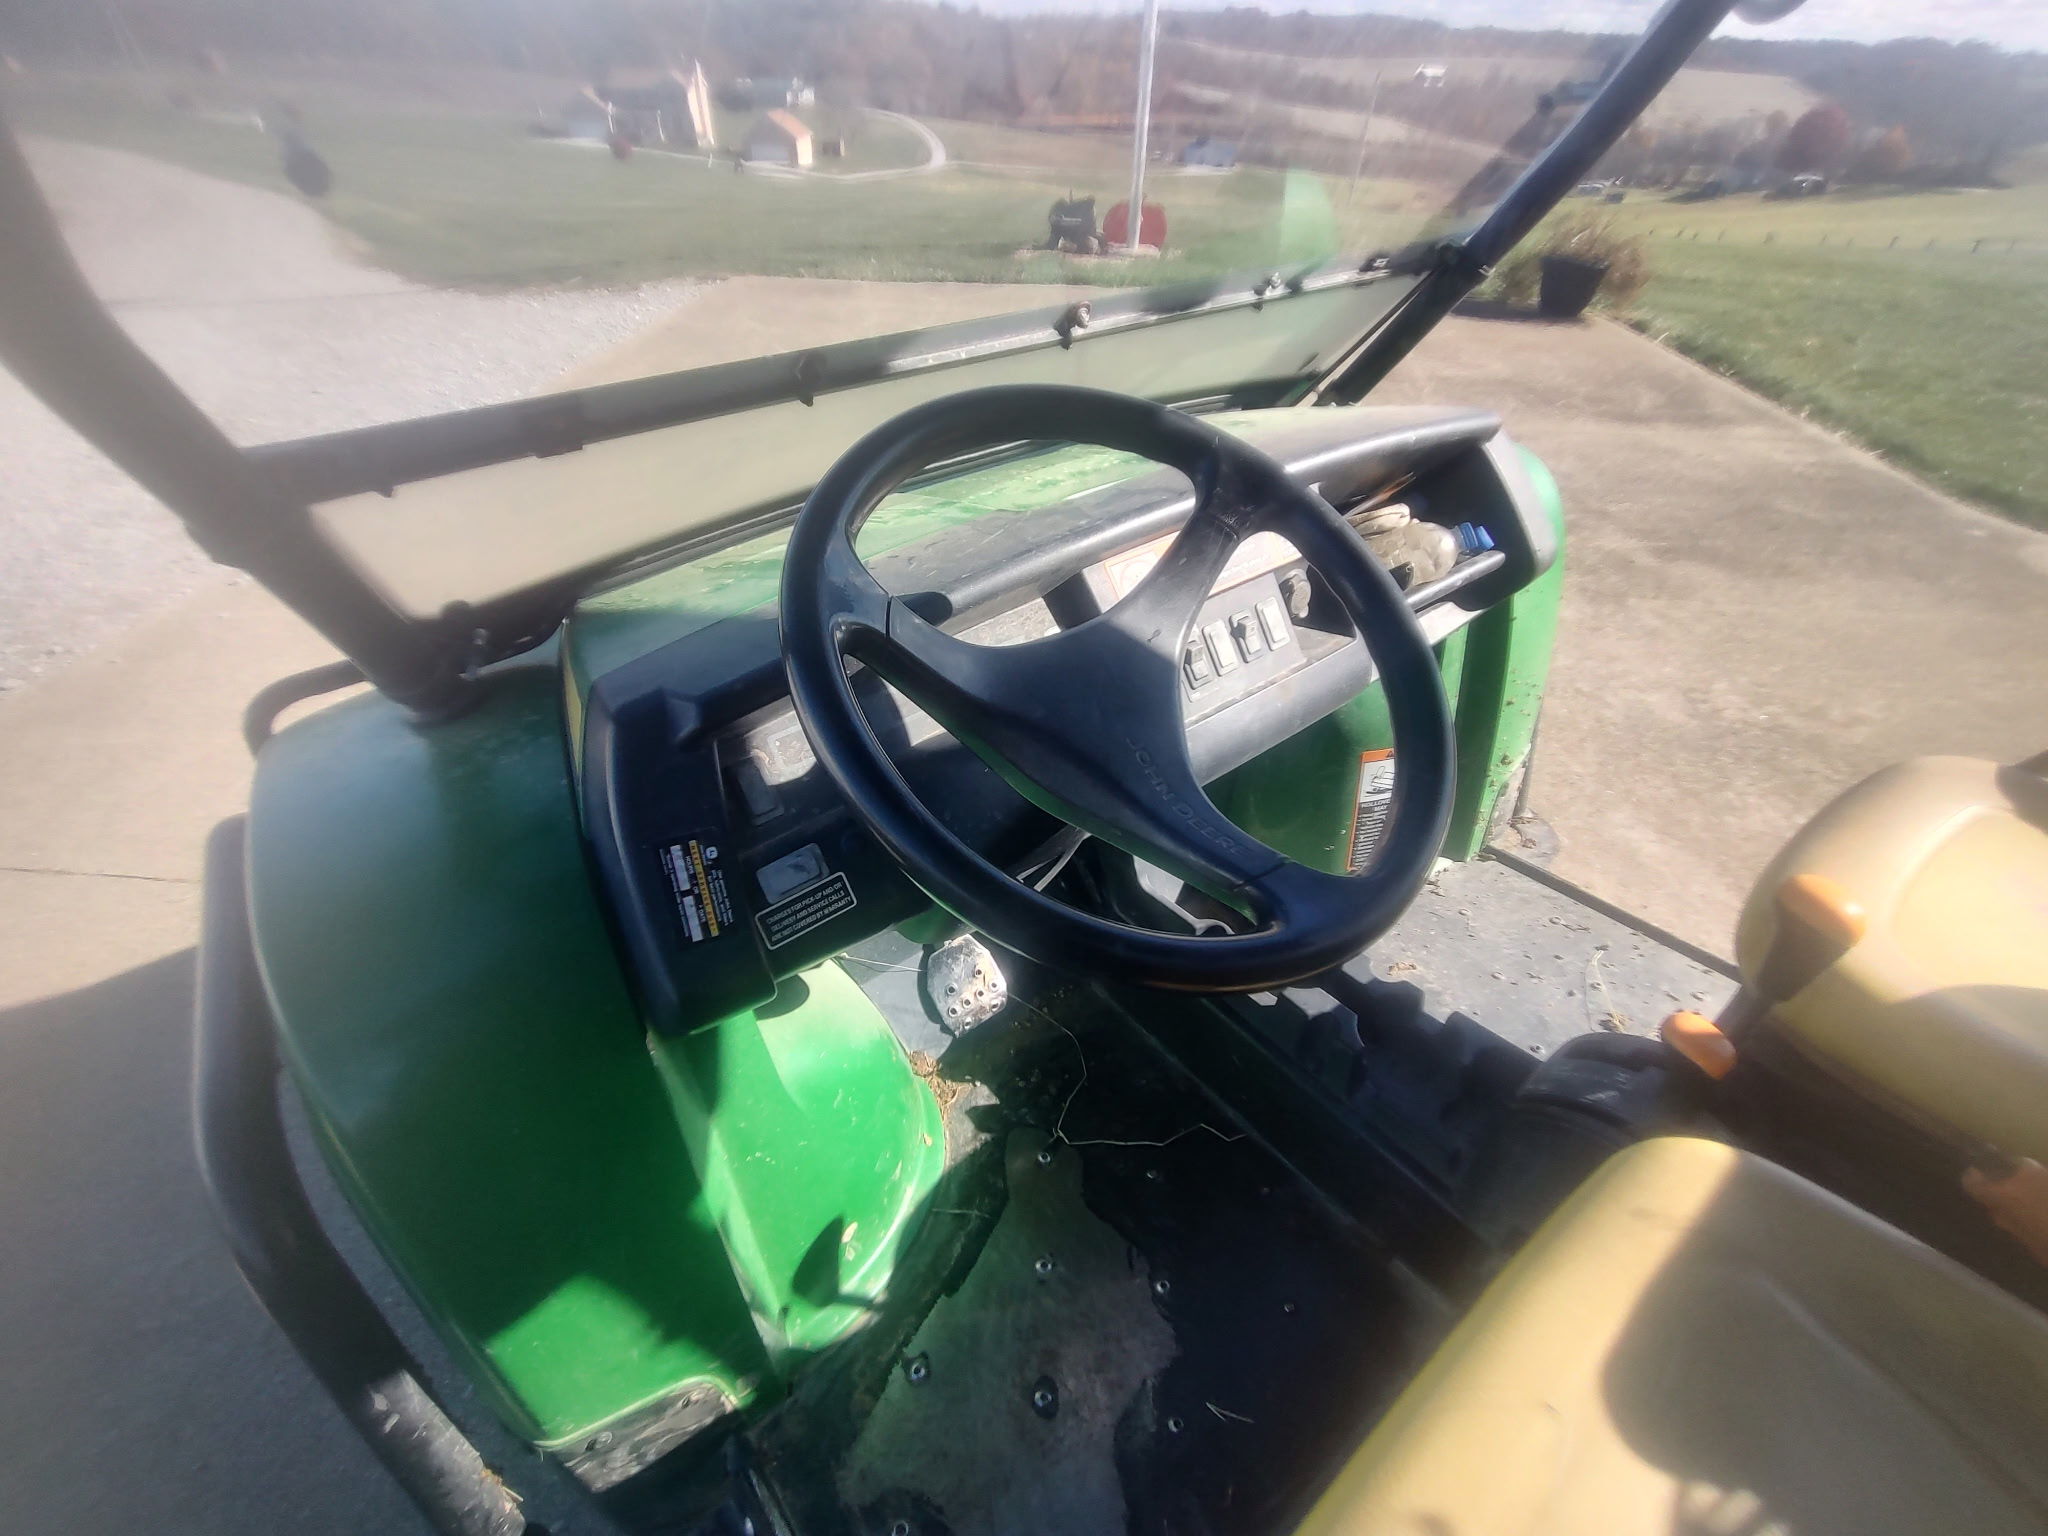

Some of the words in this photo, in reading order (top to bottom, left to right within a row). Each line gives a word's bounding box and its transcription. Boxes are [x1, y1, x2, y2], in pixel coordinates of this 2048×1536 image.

[1125, 737, 1176, 801] JOHN
[1171, 801, 1254, 856] DEERE
[791, 902, 802, 911] FOR
[802, 892, 822, 906] PICK-UP
[793, 914, 816, 930] COVERED
[823, 896, 851, 914] WARRANTY
[796, 909, 808, 919] AND
[808, 898, 829, 913] SERVICE
[828, 890, 844, 902] CALLS
